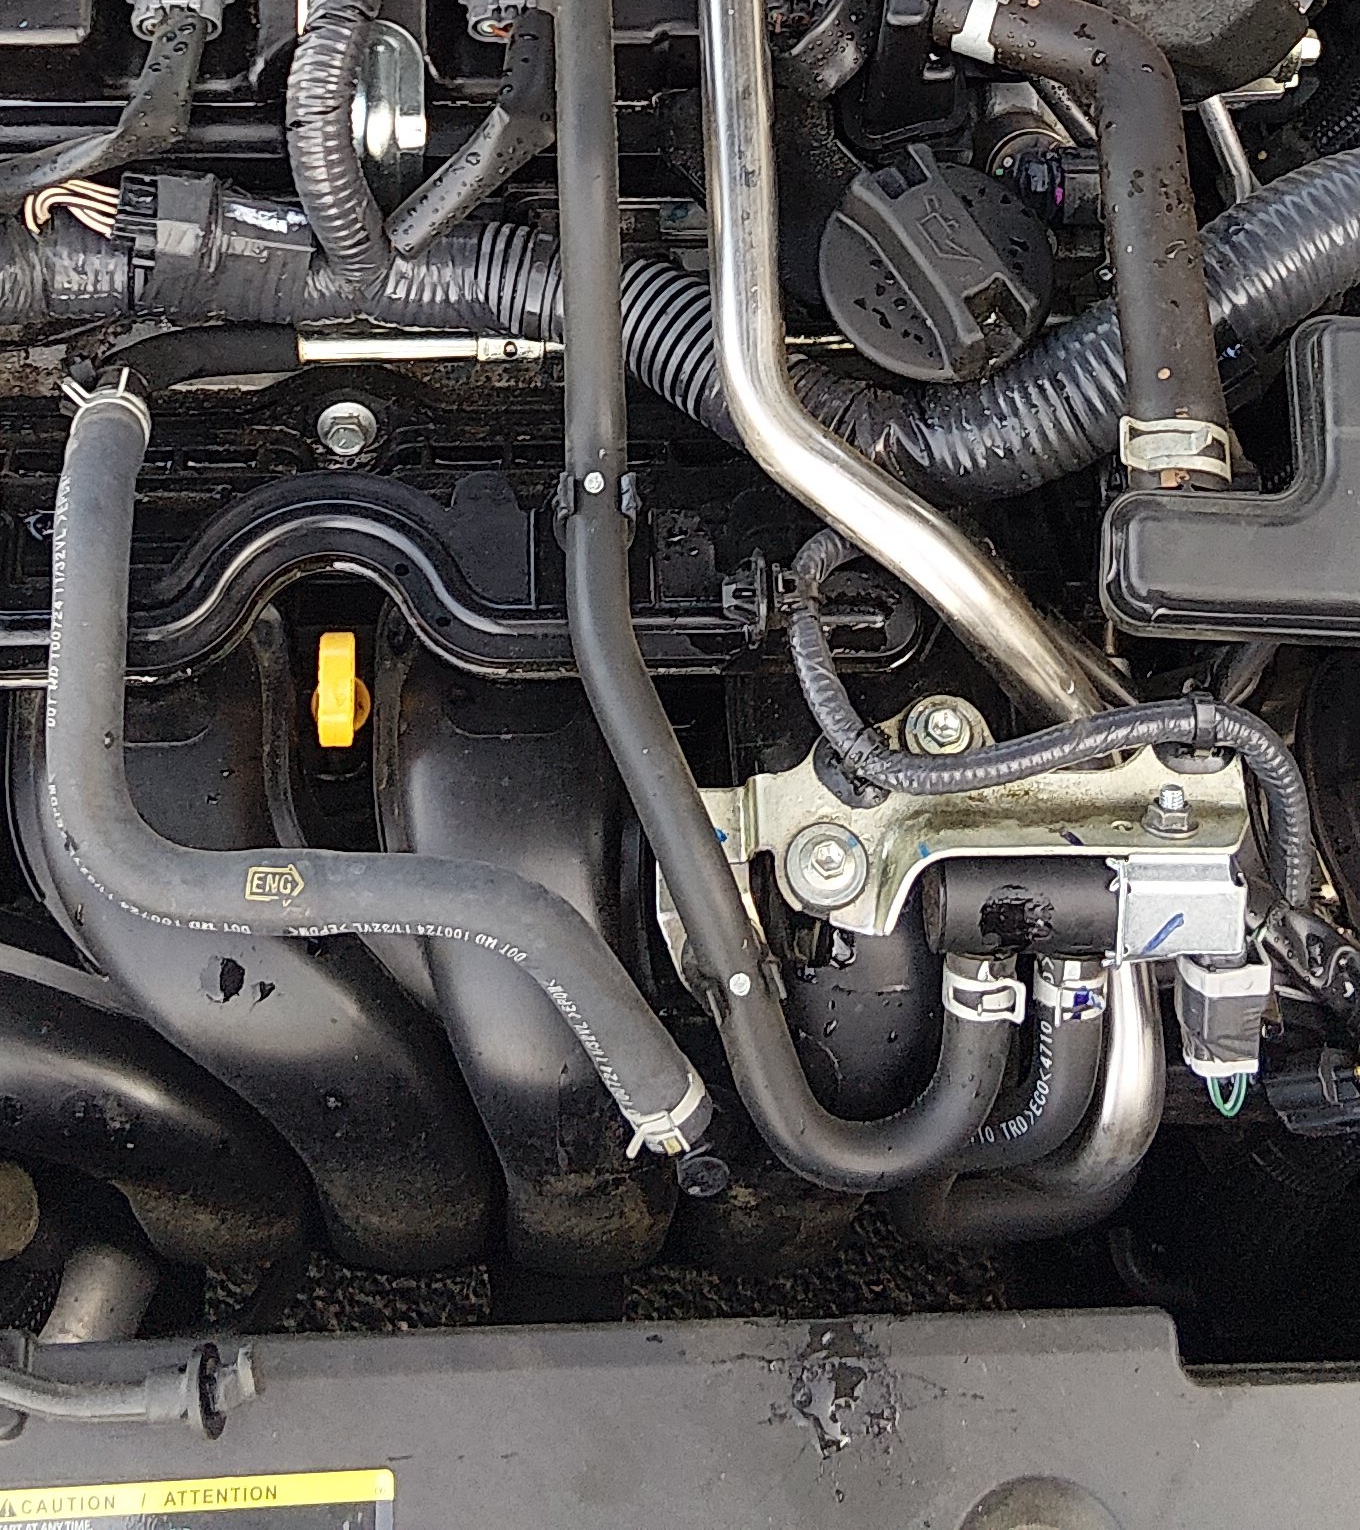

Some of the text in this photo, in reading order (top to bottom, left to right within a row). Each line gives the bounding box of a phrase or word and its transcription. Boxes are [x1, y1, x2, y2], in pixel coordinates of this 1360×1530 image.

[252, 873, 292, 895] ENG
[417, 924, 470, 941] 100724
[499, 943, 528, 963] DOT
[21, 1495, 116, 1516] CAUTION
[164, 1486, 278, 1506] ATTENTION
